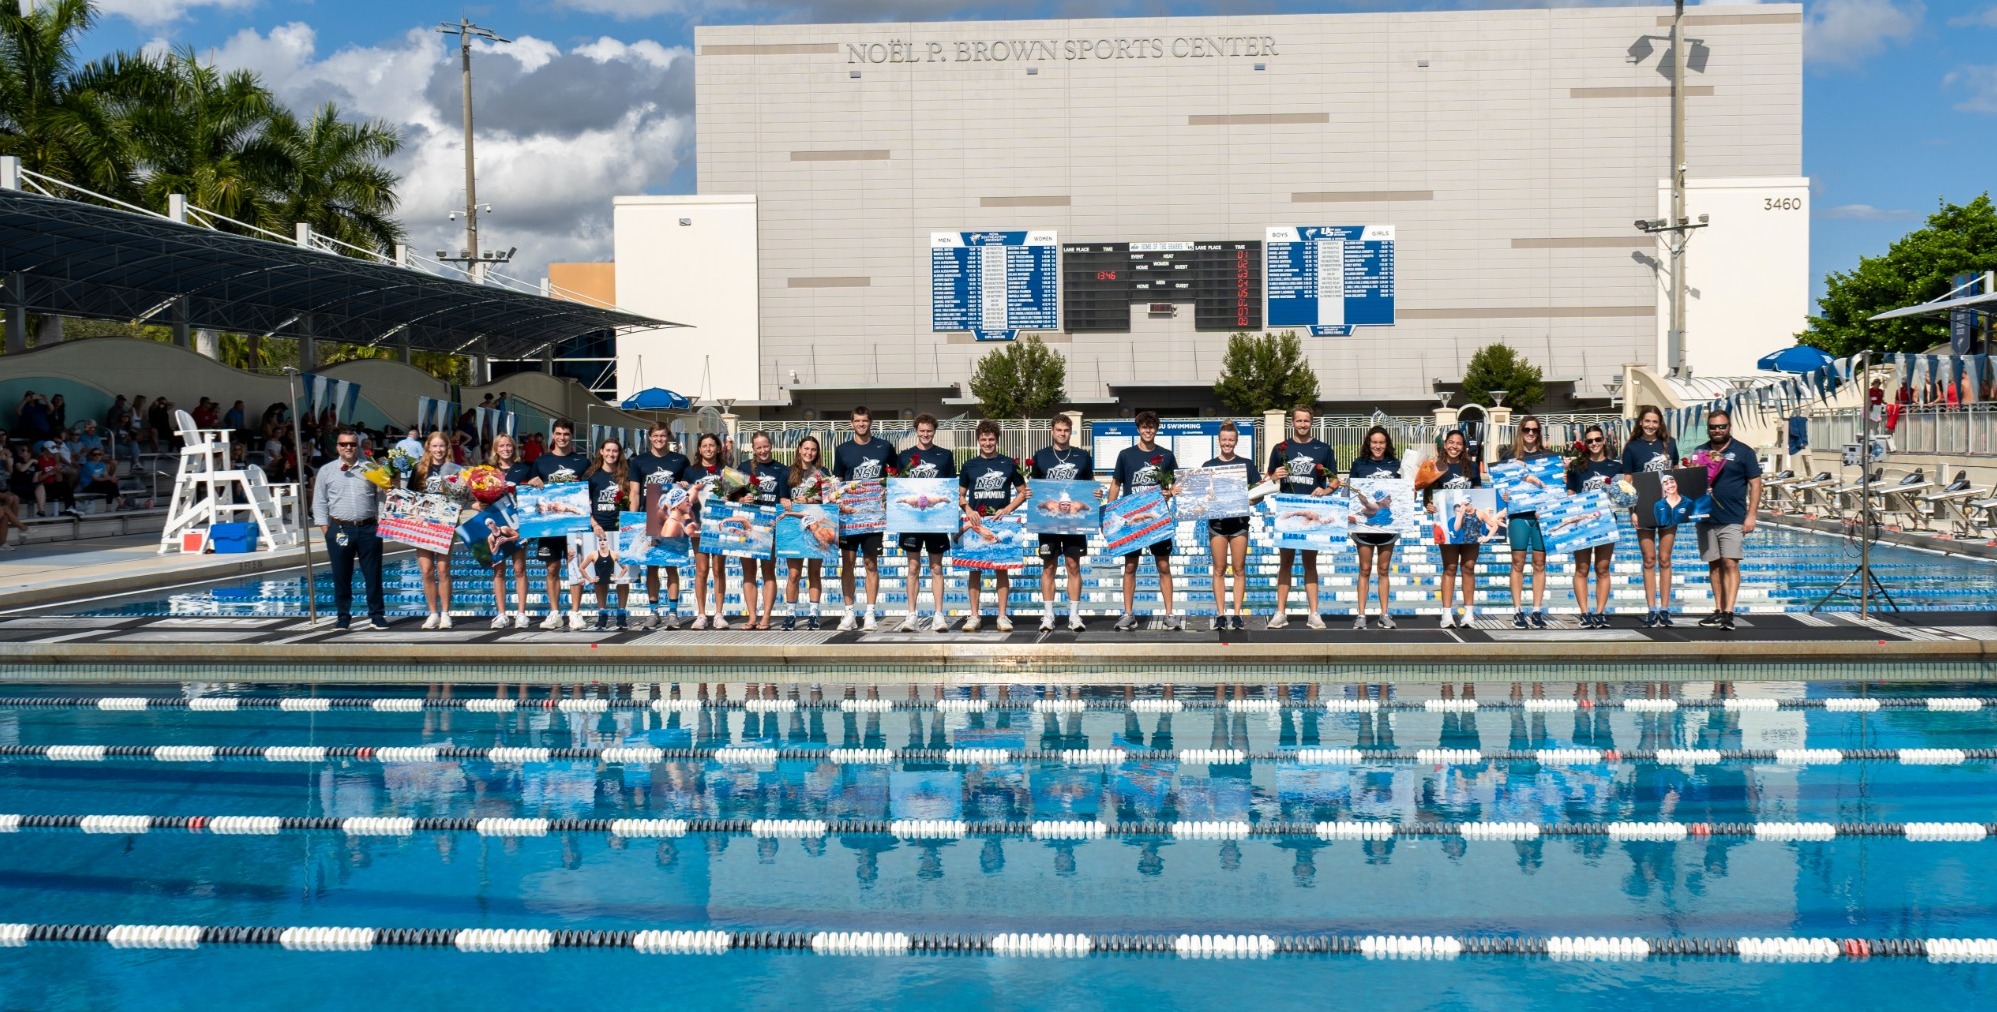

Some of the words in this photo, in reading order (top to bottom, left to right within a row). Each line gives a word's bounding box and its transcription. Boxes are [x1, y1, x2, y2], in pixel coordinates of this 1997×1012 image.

[847, 39, 919, 64] NOËL
[926, 42, 946, 62] P.
[954, 40, 1057, 62] BROWN
[1064, 38, 1163, 60] SPORTS
[1171, 36, 1279, 58] CENTER
[1764, 198, 1801, 210] 3460
[853, 466, 882, 480] NSU
[1046, 468, 1079, 480] NSU
[974, 476, 1007, 490] NSU
[598, 490, 615, 503] NS
[974, 491, 1006, 499] SWIMMING
